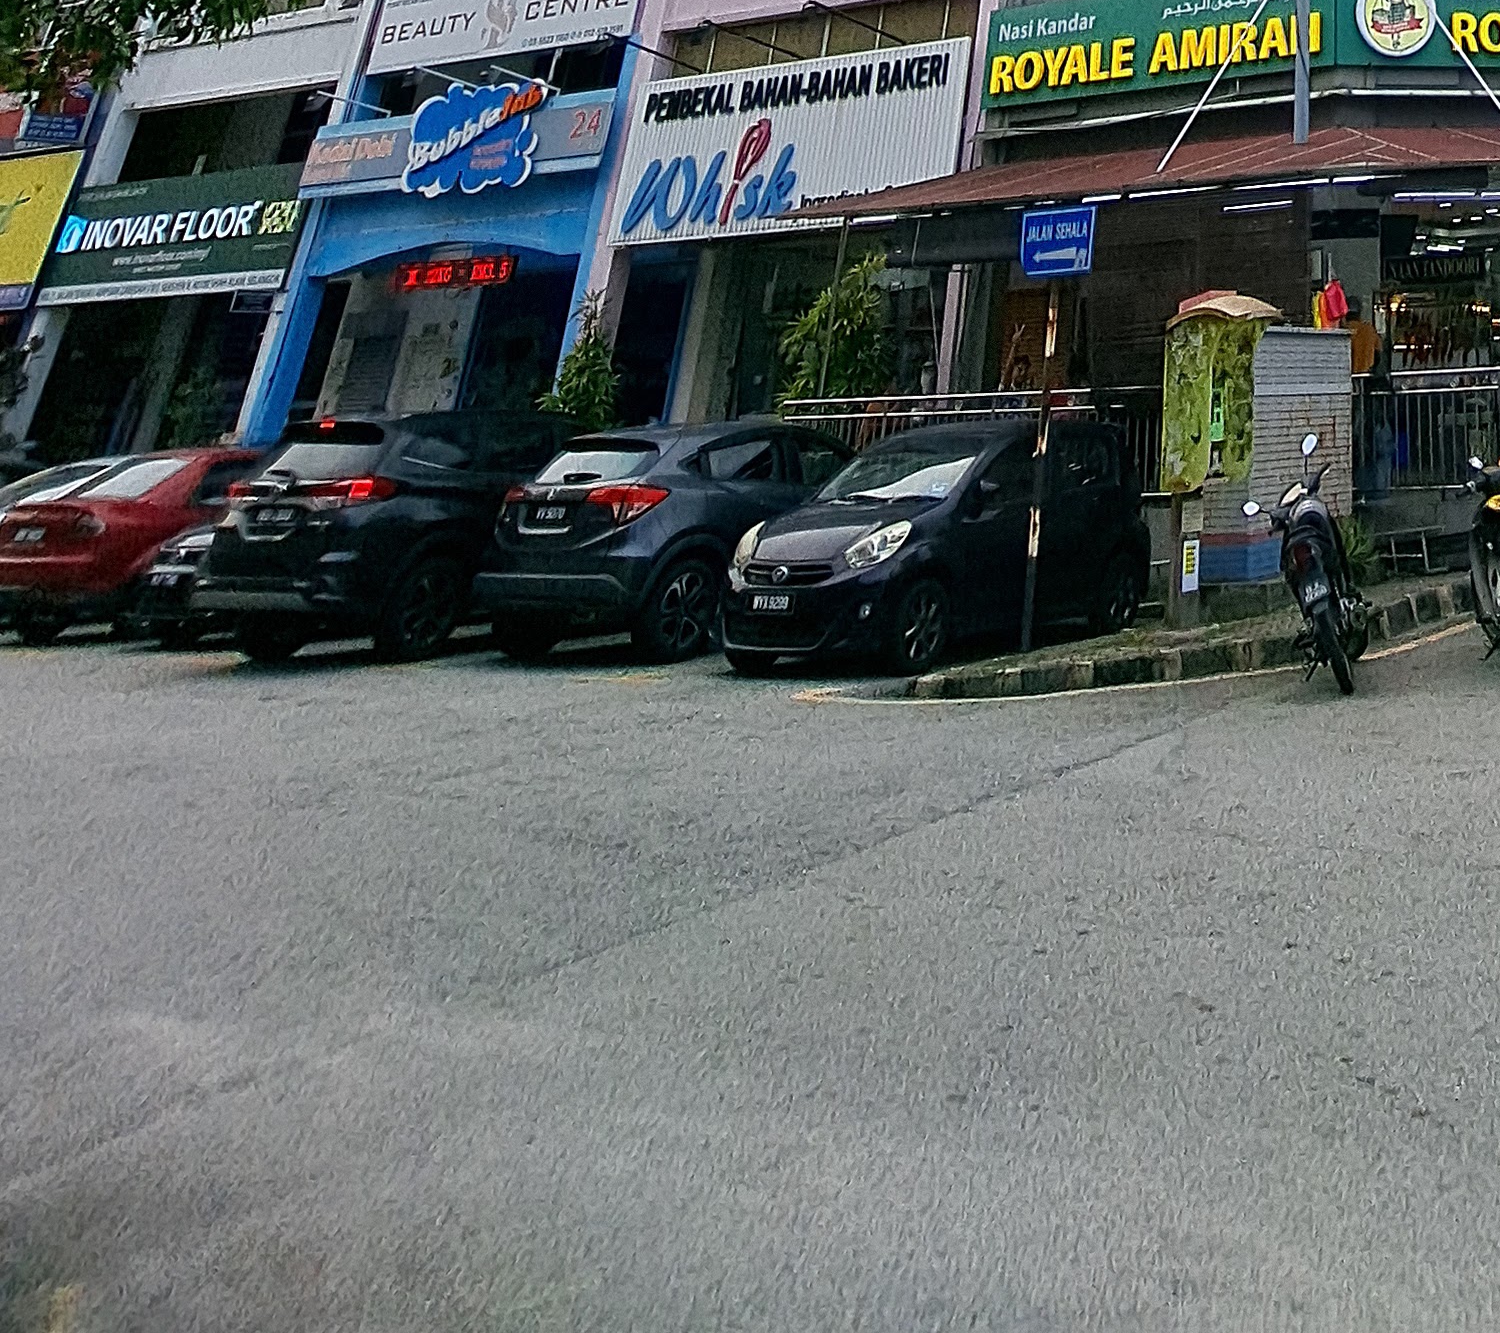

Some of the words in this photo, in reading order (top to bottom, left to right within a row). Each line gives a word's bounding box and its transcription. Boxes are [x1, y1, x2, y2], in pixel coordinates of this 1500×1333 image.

[381, 11, 477, 45] BEAUTY
[998, 17, 1034, 42] Nasi
[1036, 12, 1096, 37] Kandar
[989, 36, 1136, 96] ROYALE
[1148, 11, 1321, 75] AMIRAH
[643, 83, 735, 123] PEMBEKAL
[738, 63, 875, 113] BAHAN-BAHAN
[876, 52, 950, 95] BAKERI
[570, 109, 602, 140] 24
[81, 213, 170, 252] INOVAR
[169, 204, 254, 244] FLOOR
[1026, 224, 1054, 243] JALAN
[1055, 220, 1089, 240] SEHALA
